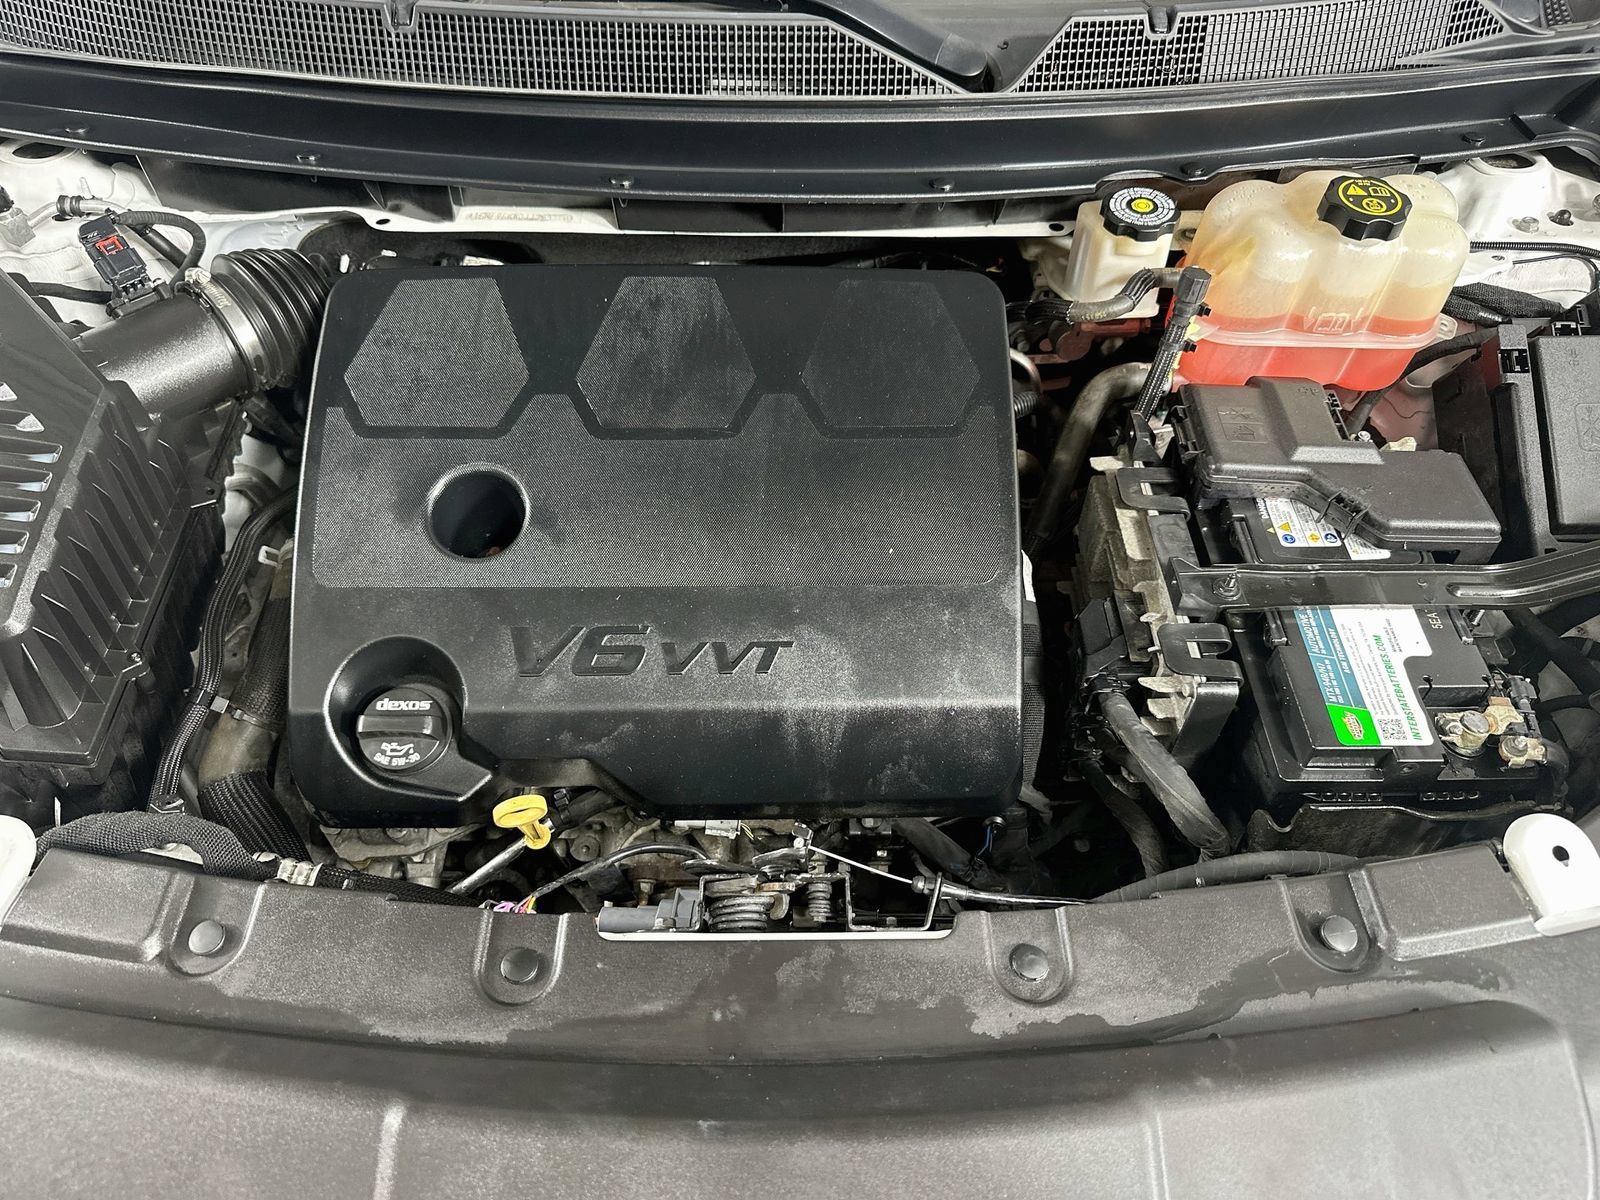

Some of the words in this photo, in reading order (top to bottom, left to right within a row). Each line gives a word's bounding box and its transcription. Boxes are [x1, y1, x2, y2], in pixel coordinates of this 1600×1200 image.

[1256, 498, 1269, 518] DANGE
[1299, 614, 1320, 653] AUTOMOTIVE
[1328, 627, 1346, 661] TECHNOLOGY
[510, 625, 650, 677] V6
[660, 641, 795, 675] VVT
[376, 697, 434, 711] dexos
[1372, 634, 1423, 741] INTERSTATEBATTERIES.COM
[373, 752, 390, 766] SAE
[391, 752, 420, 766] 5W-30
